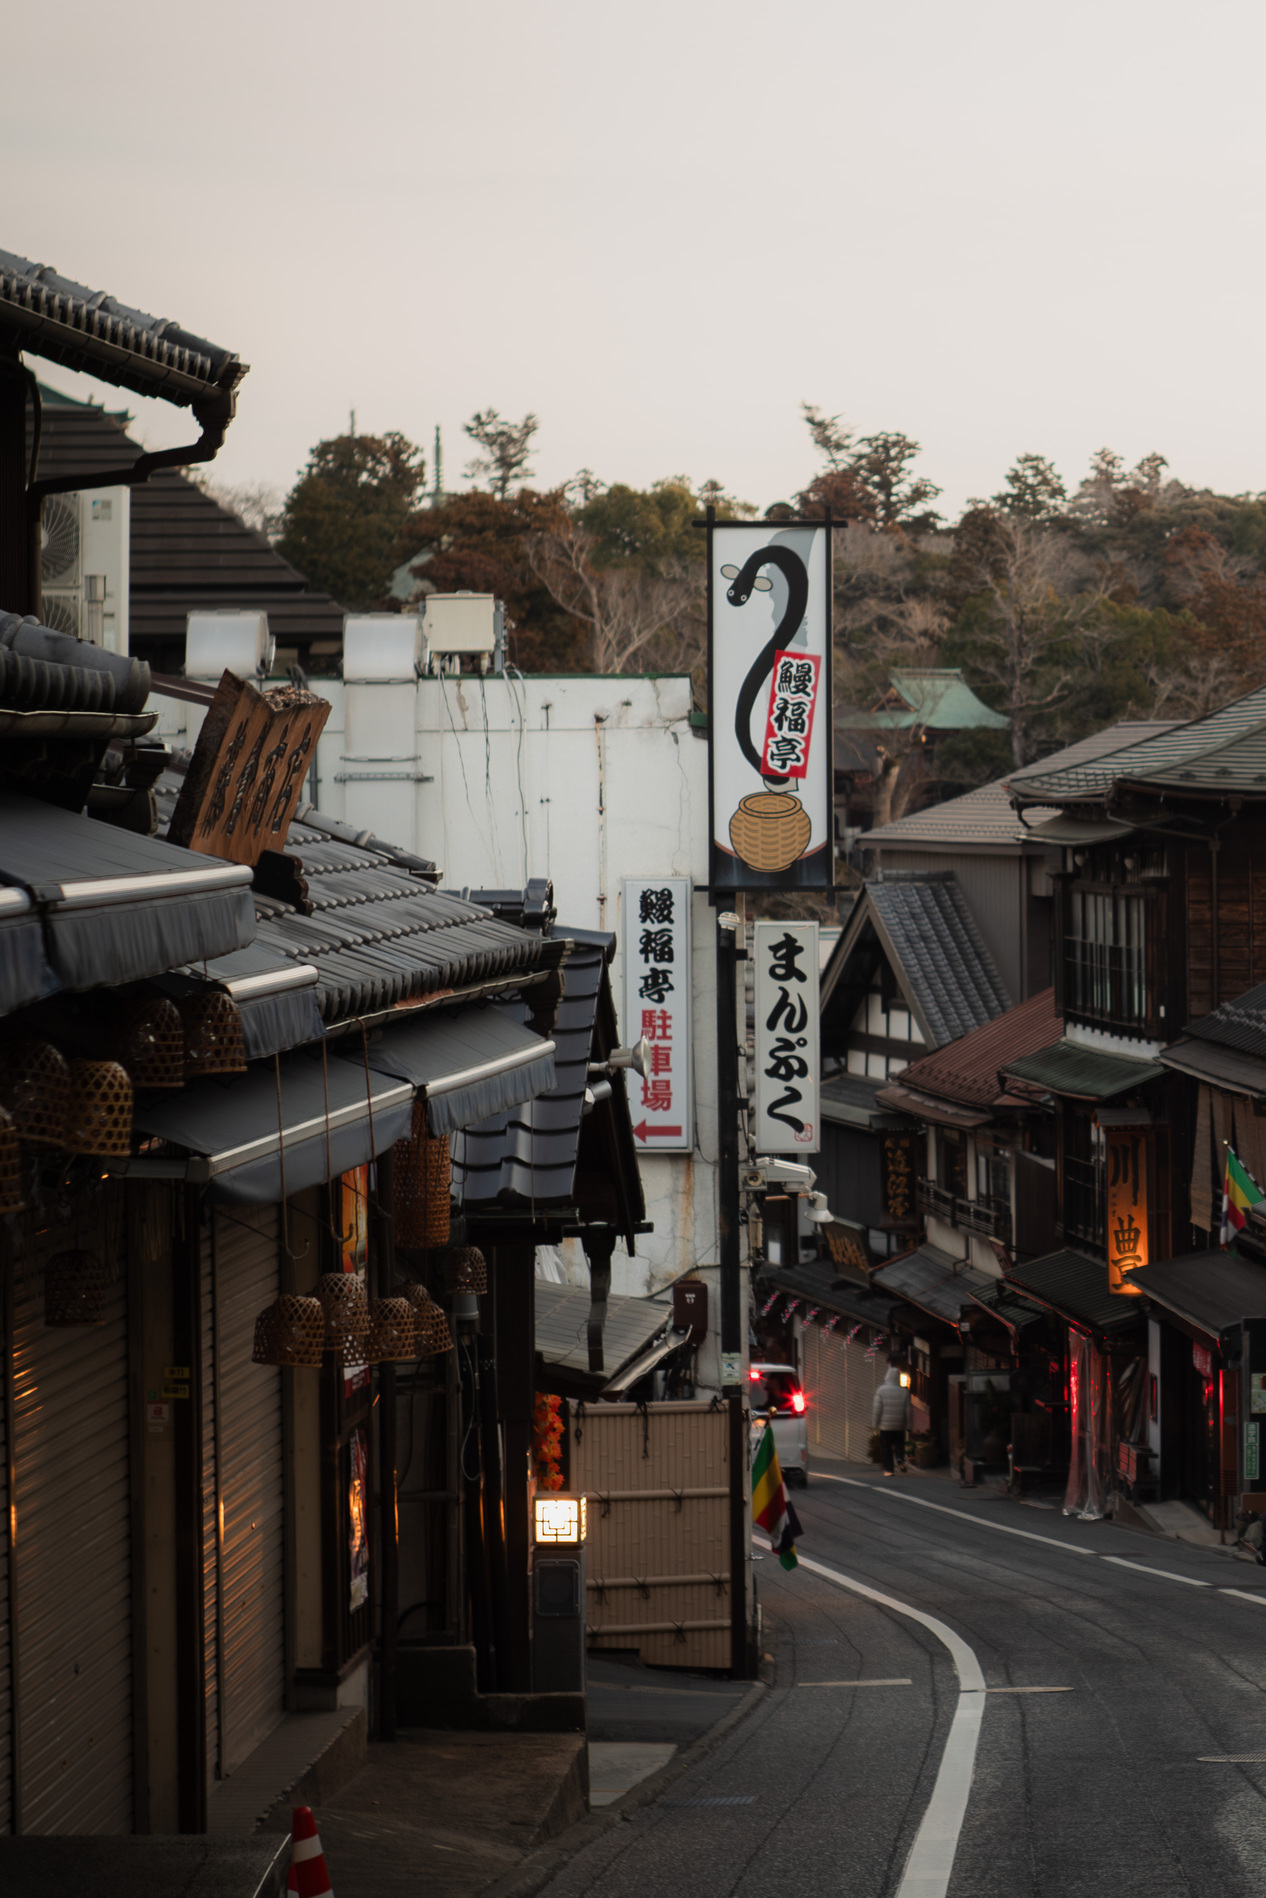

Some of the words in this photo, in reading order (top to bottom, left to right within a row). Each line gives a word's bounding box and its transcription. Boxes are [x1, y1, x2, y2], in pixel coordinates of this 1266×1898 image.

[767, 659, 815, 770] 鰻福亭
[638, 887, 675, 1004] 鰻福亭
[640, 1008, 674, 1111] 駐車場
[764, 933, 809, 1134] まんぷく
[1110, 1136, 1143, 1291] 川豊
